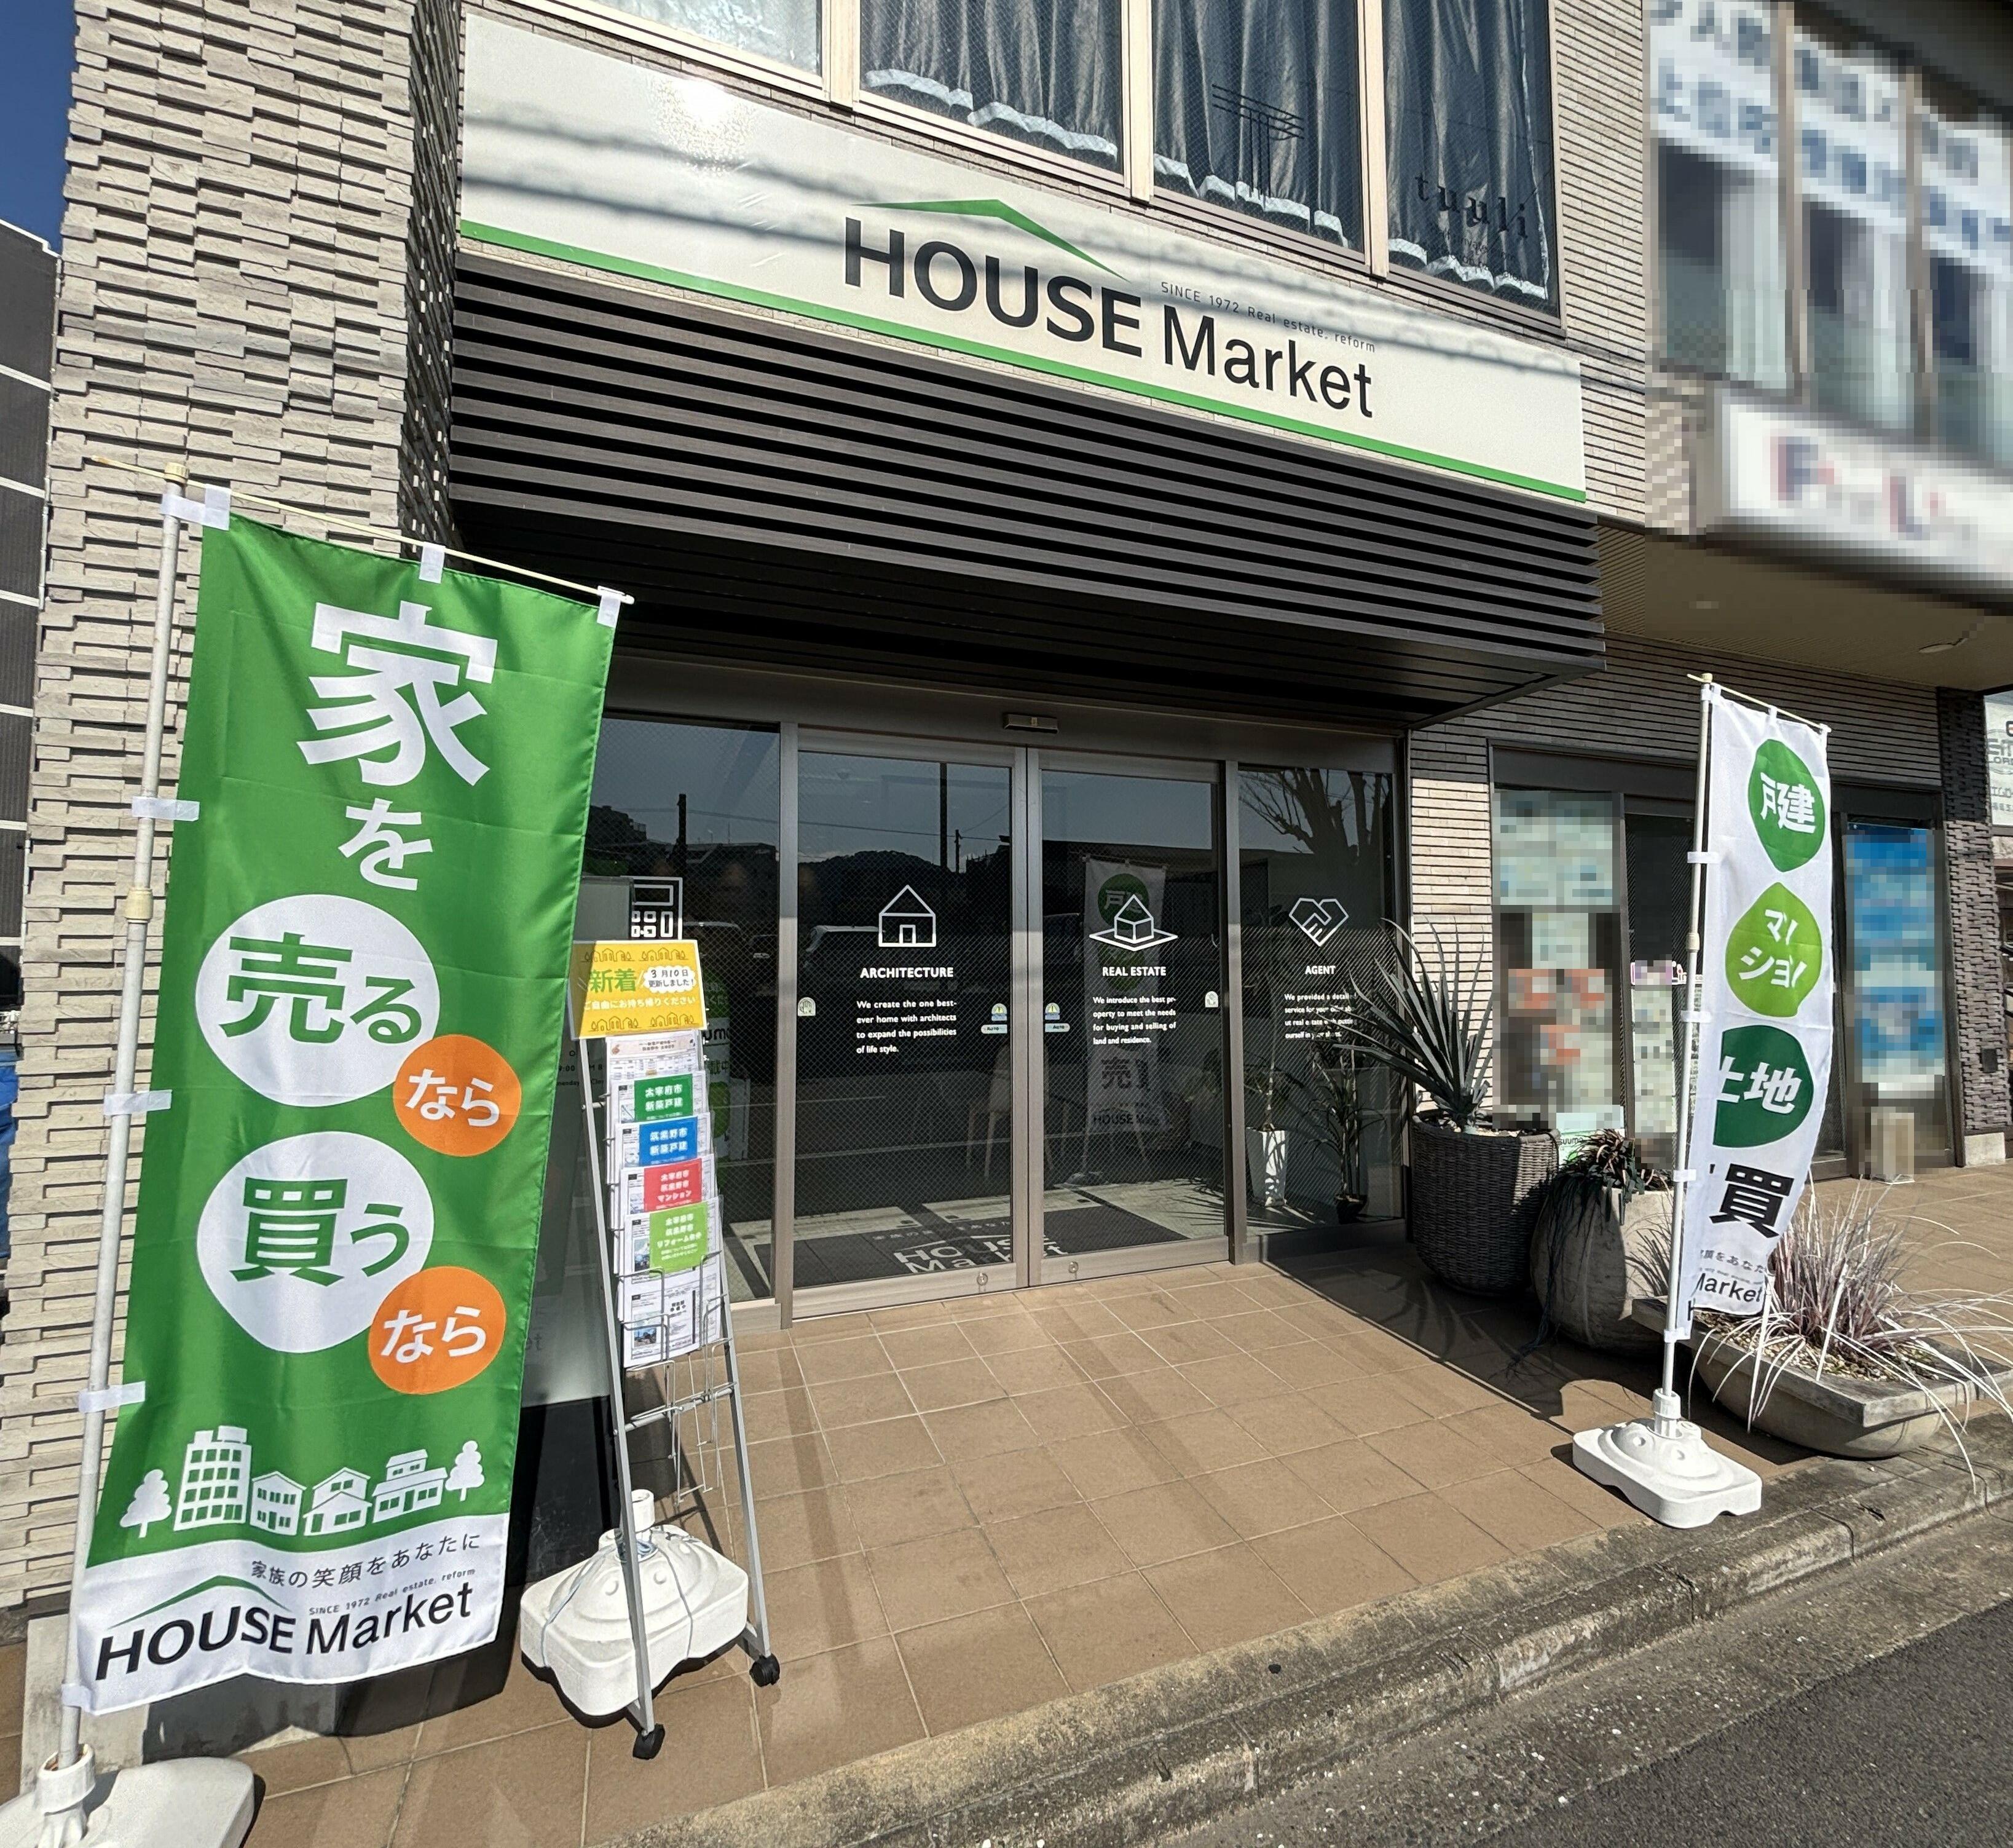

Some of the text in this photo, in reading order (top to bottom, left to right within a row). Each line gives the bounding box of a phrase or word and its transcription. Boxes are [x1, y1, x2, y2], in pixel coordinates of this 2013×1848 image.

[845, 216, 1374, 418] HOUSE Market
[1162, 282, 1200, 302] SINCE
[1210, 295, 1240, 314] 1972
[1248, 306, 1275, 324] Real
[1335, 333, 1375, 352] reform
[296, 601, 497, 891] 家を
[861, 967, 954, 978] ARCHITECTURE
[1103, 966, 1167, 976] REAL ESTATE
[1305, 965, 1336, 975] AGENT
[219, 932, 422, 1043] 売る
[590, 968, 636, 993] 新着
[873, 1000, 900, 1009] create
[903, 1000, 916, 1008] the
[937, 999, 957, 1008] best-
[1297, 993, 1325, 1002] provided
[877, 1015, 899, 1024] home
[900, 1014, 918, 1023] with
[920, 1014, 957, 1022] architects
[1106, 1023, 1130, 1033] buying
[1145, 1022, 1168, 1031] selling
[868, 1029, 896, 1040] expand
[899, 1029, 911, 1038] the
[913, 1028, 957, 1039] possibilities
[856, 1044, 899, 1055] of life style.
[406, 1070, 501, 1126] なら
[229, 1177, 410, 1287] 買う
[381, 1306, 486, 1362] なら
[253, 1533, 479, 1587] 家族の笑顔をあなたに
[309, 1606, 340, 1616] SINCE
[346, 1600, 370, 1610] 1972
[95, 1582, 473, 1680] HOUSE Market
